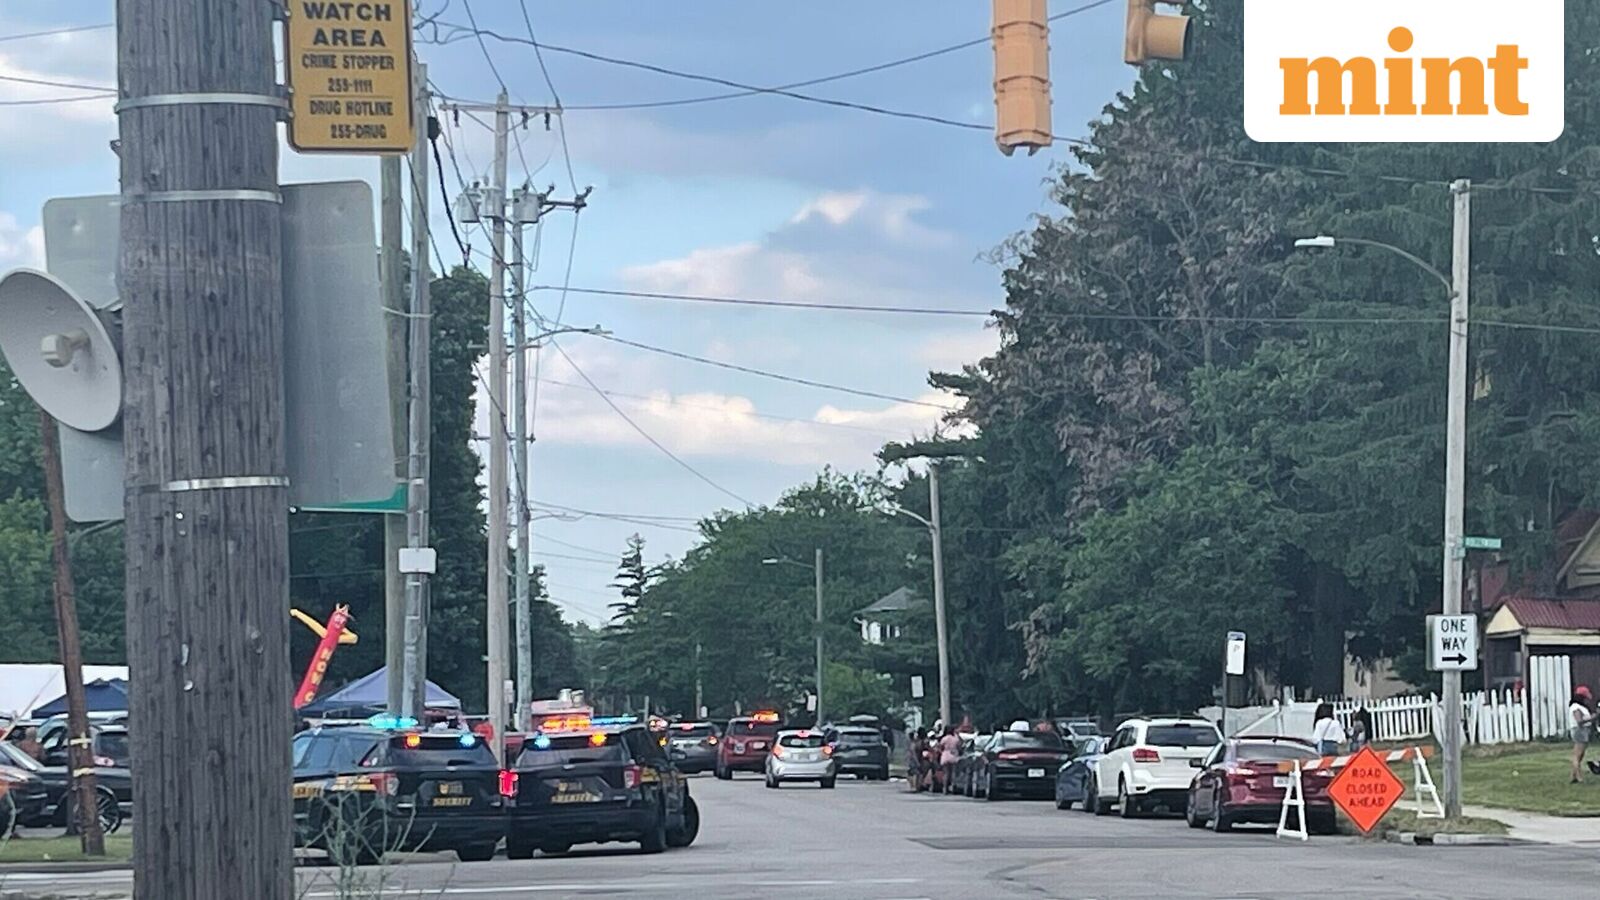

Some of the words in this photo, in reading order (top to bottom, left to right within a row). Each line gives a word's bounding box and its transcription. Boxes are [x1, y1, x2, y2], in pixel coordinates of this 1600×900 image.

[303, 2, 392, 20] WATCH
[313, 28, 386, 47] AREA
[342, 54, 395, 70] STOPPER
[309, 100, 342, 115] DRUG
[345, 101, 394, 116] HOTLINE
[330, 124, 387, 139] 255-DRUG
[1441, 618, 1467, 632] ONE
[1441, 637, 1467, 650] WAY
[1352, 768, 1382, 778] ROAD
[1346, 784, 1388, 795] CLOSED
[1349, 797, 1386, 807] AHEAD
